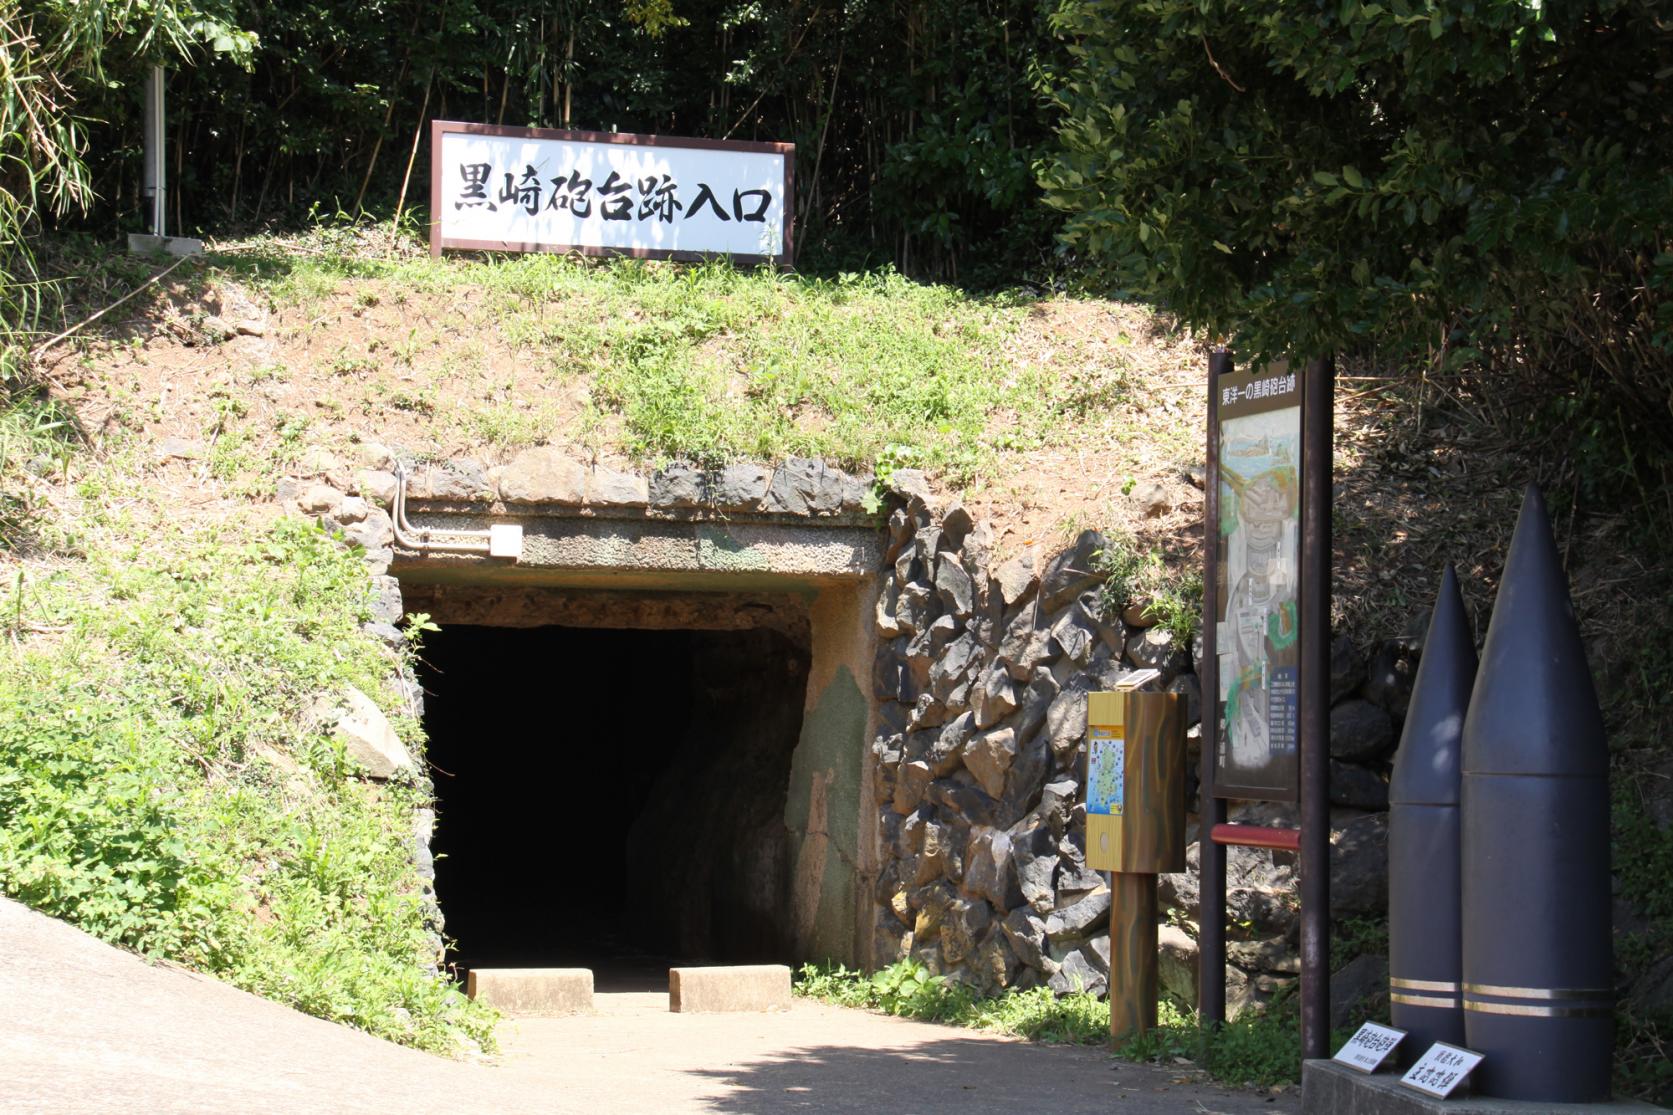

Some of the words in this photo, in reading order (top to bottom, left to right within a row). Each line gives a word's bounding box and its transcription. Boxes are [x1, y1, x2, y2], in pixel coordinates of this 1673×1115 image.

[454, 162, 772, 223] 黒崎砲台跡入口
[1222, 375, 1296, 406] 東洋一の黒崎砲台跡
